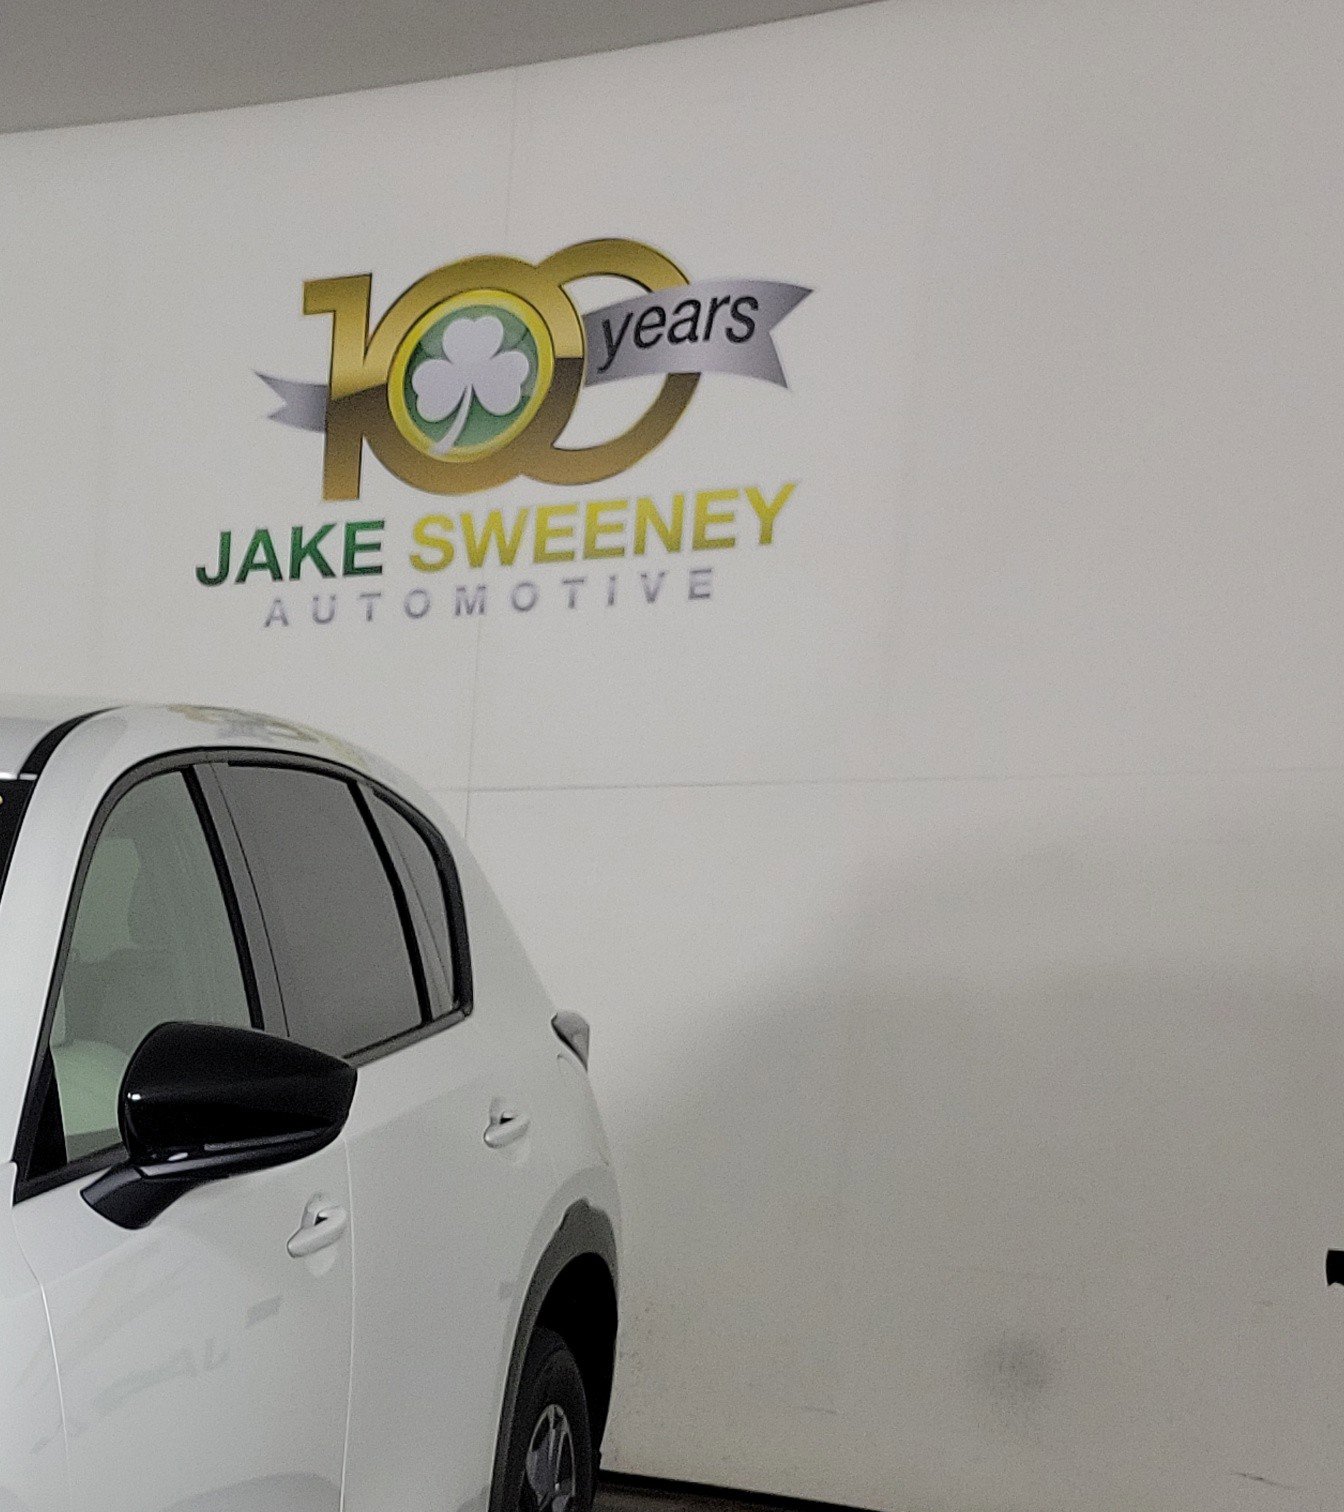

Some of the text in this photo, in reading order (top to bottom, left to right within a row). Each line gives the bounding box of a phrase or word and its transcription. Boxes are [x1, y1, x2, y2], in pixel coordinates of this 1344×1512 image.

[302, 237, 760, 500] 100 years
[194, 480, 802, 588] JAKE SWEENEY
[263, 567, 714, 630] AUTOMOTIVE
